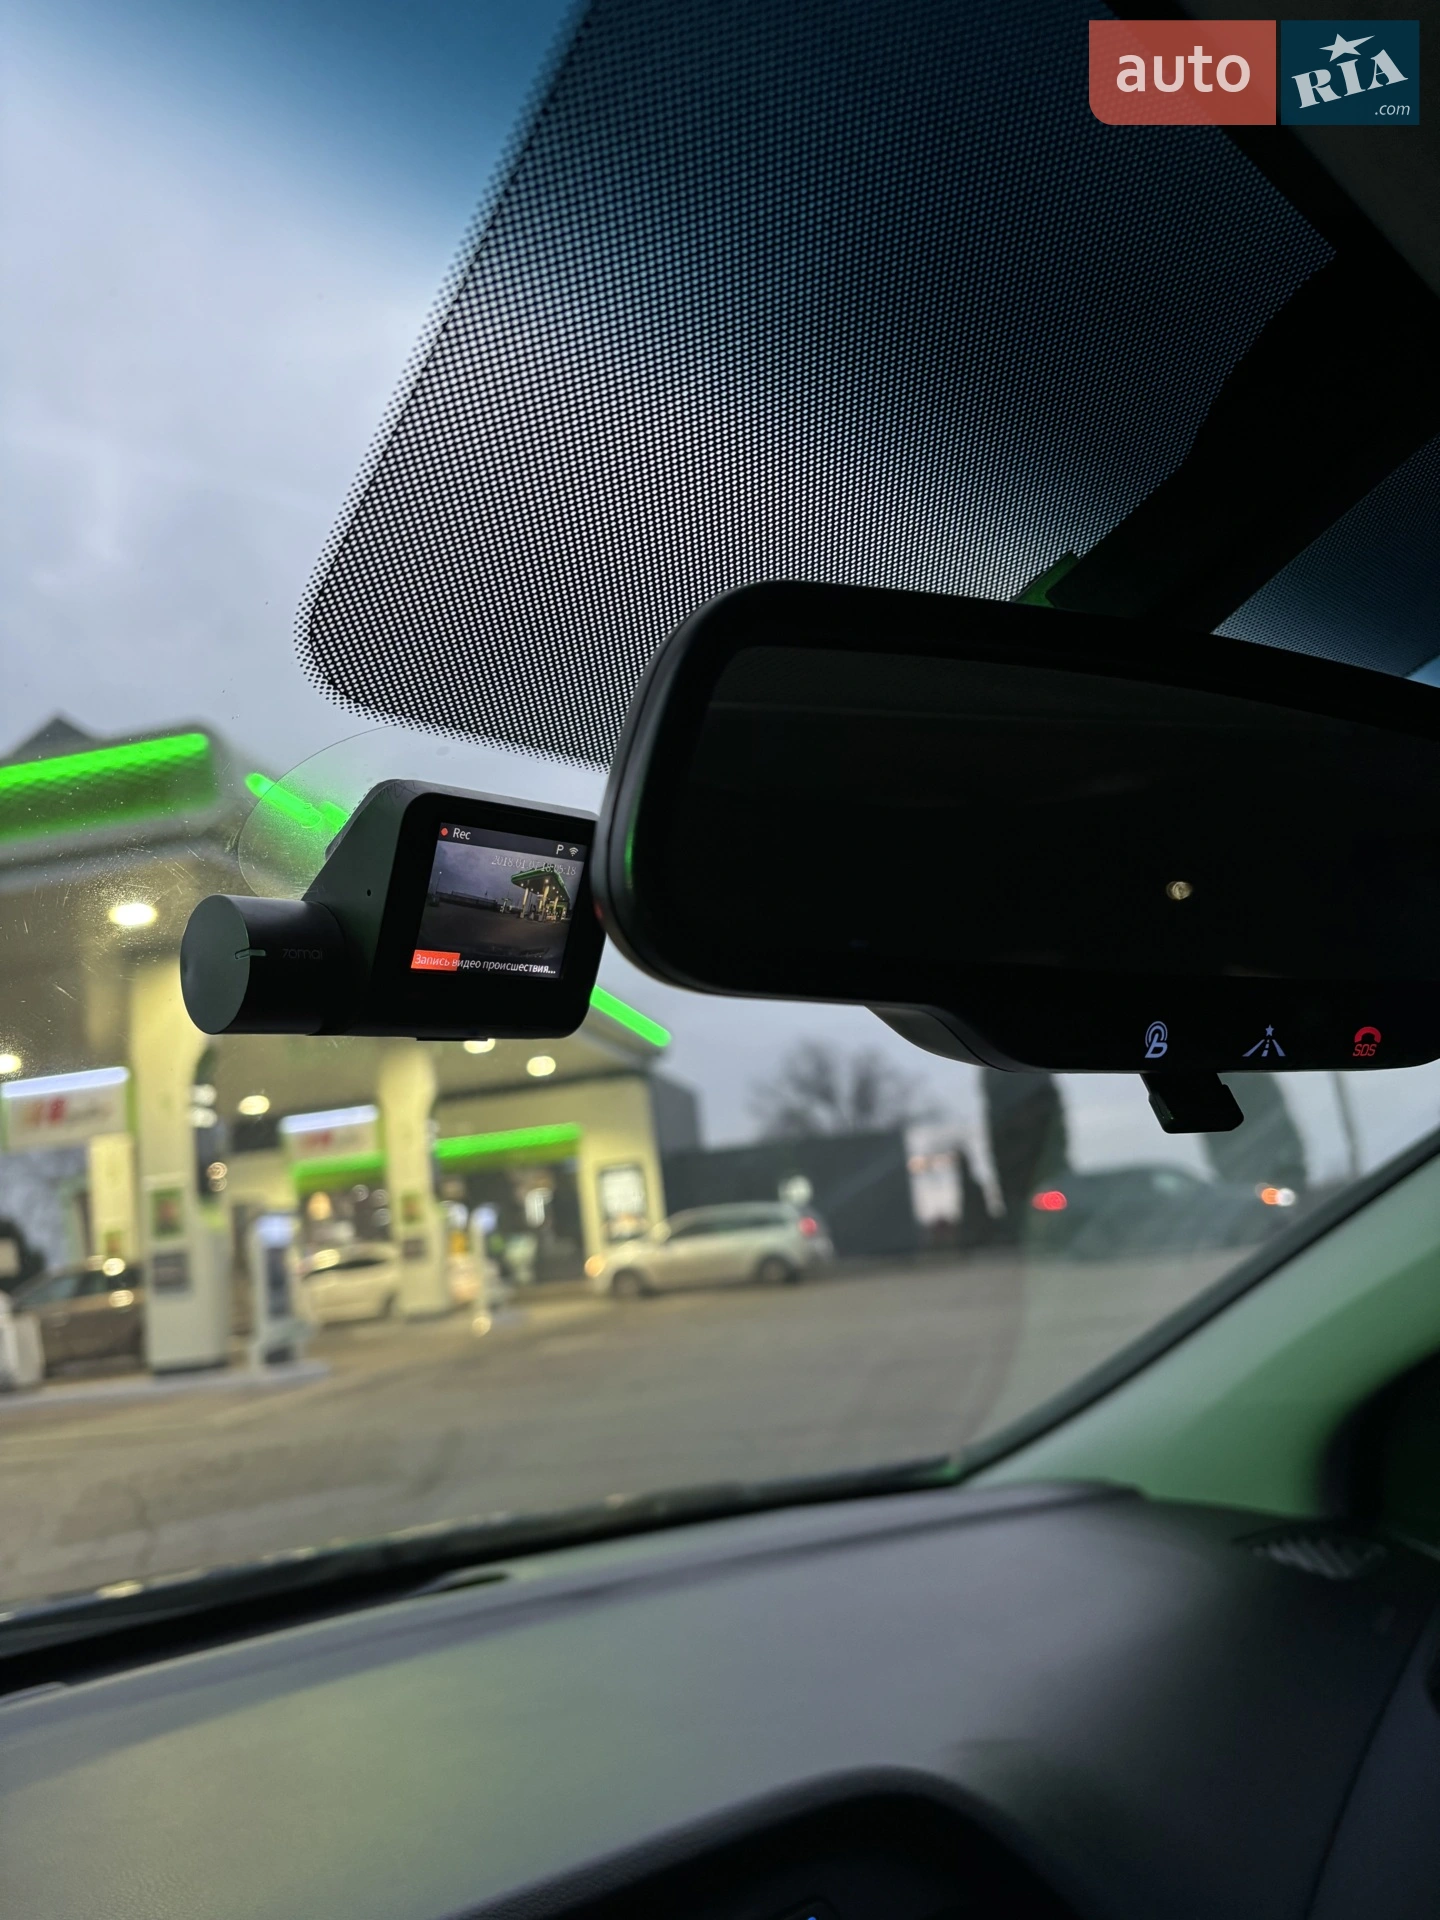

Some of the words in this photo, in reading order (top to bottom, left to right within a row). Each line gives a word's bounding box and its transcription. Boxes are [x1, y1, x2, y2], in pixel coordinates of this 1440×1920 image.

[452, 827, 471, 841] Rec
[555, 844, 565, 855] P
[415, 953, 451, 967] Запись
[451, 958, 482, 970] видео
[482, 960, 556, 975] происшествия...
[1352, 1043, 1377, 1057] SOS
